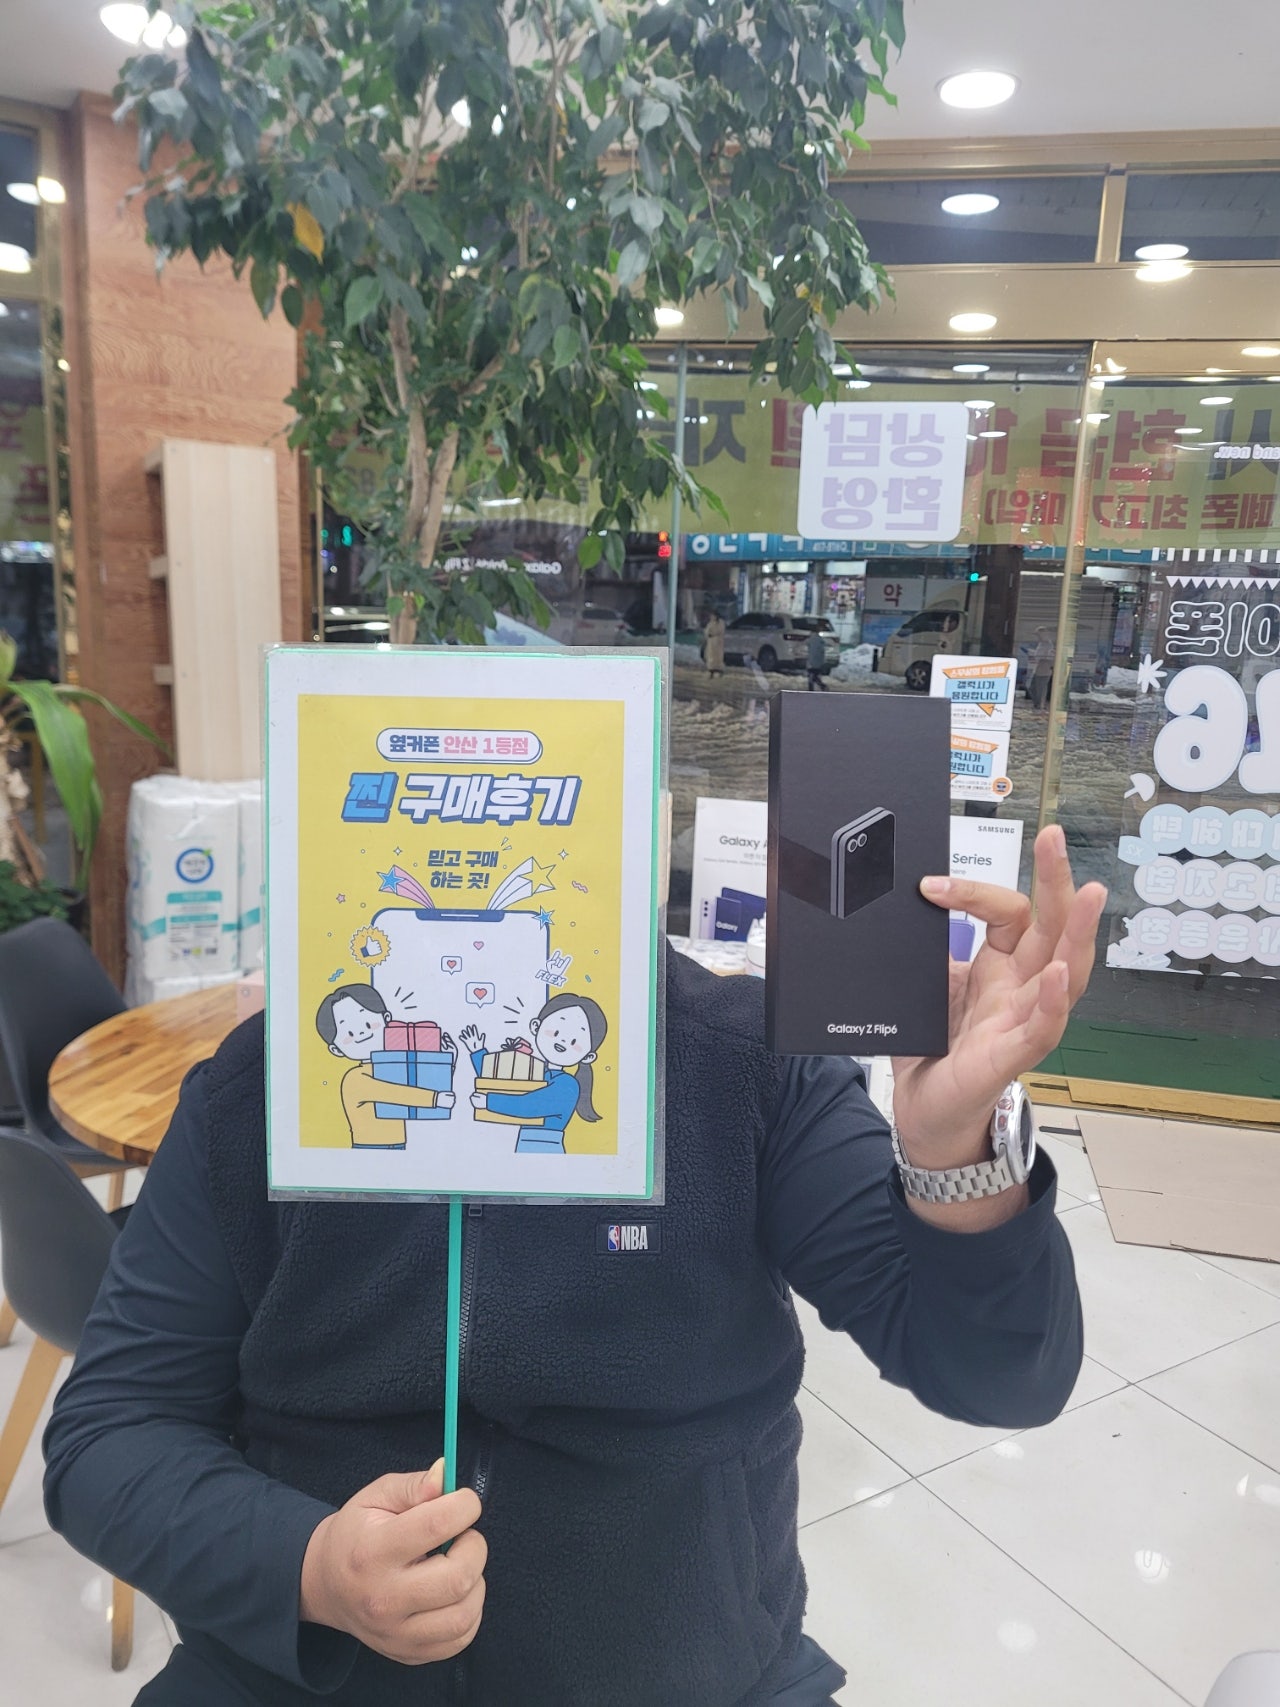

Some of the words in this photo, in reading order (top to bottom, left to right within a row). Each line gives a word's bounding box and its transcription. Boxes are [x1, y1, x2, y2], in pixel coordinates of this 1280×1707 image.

[957, 680, 995, 690] 갤럭시가
[952, 690, 999, 701] 응원합니다
[389, 735, 440, 753] 옆커폰
[443, 737, 477, 754] 안산
[483, 737, 529, 755] 1등점
[341, 772, 399, 822] 찐
[399, 773, 582, 826] 구매후기
[977, 825, 1015, 834] SAMSUNG
[427, 850, 461, 867] 믿고
[465, 851, 499, 868] 구매
[719, 835, 760, 850] Galaxy
[952, 853, 992, 866] Series
[430, 871, 463, 889] 하는
[467, 873, 490, 889] 곳!
[715, 921, 738, 933] Galaxy
[535, 969, 567, 987] FLEX
[827, 1023, 865, 1036] Galaxy
[866, 1024, 872, 1034] Z
[873, 1024, 898, 1037] Flip6
[620, 1225, 648, 1250] NBA
